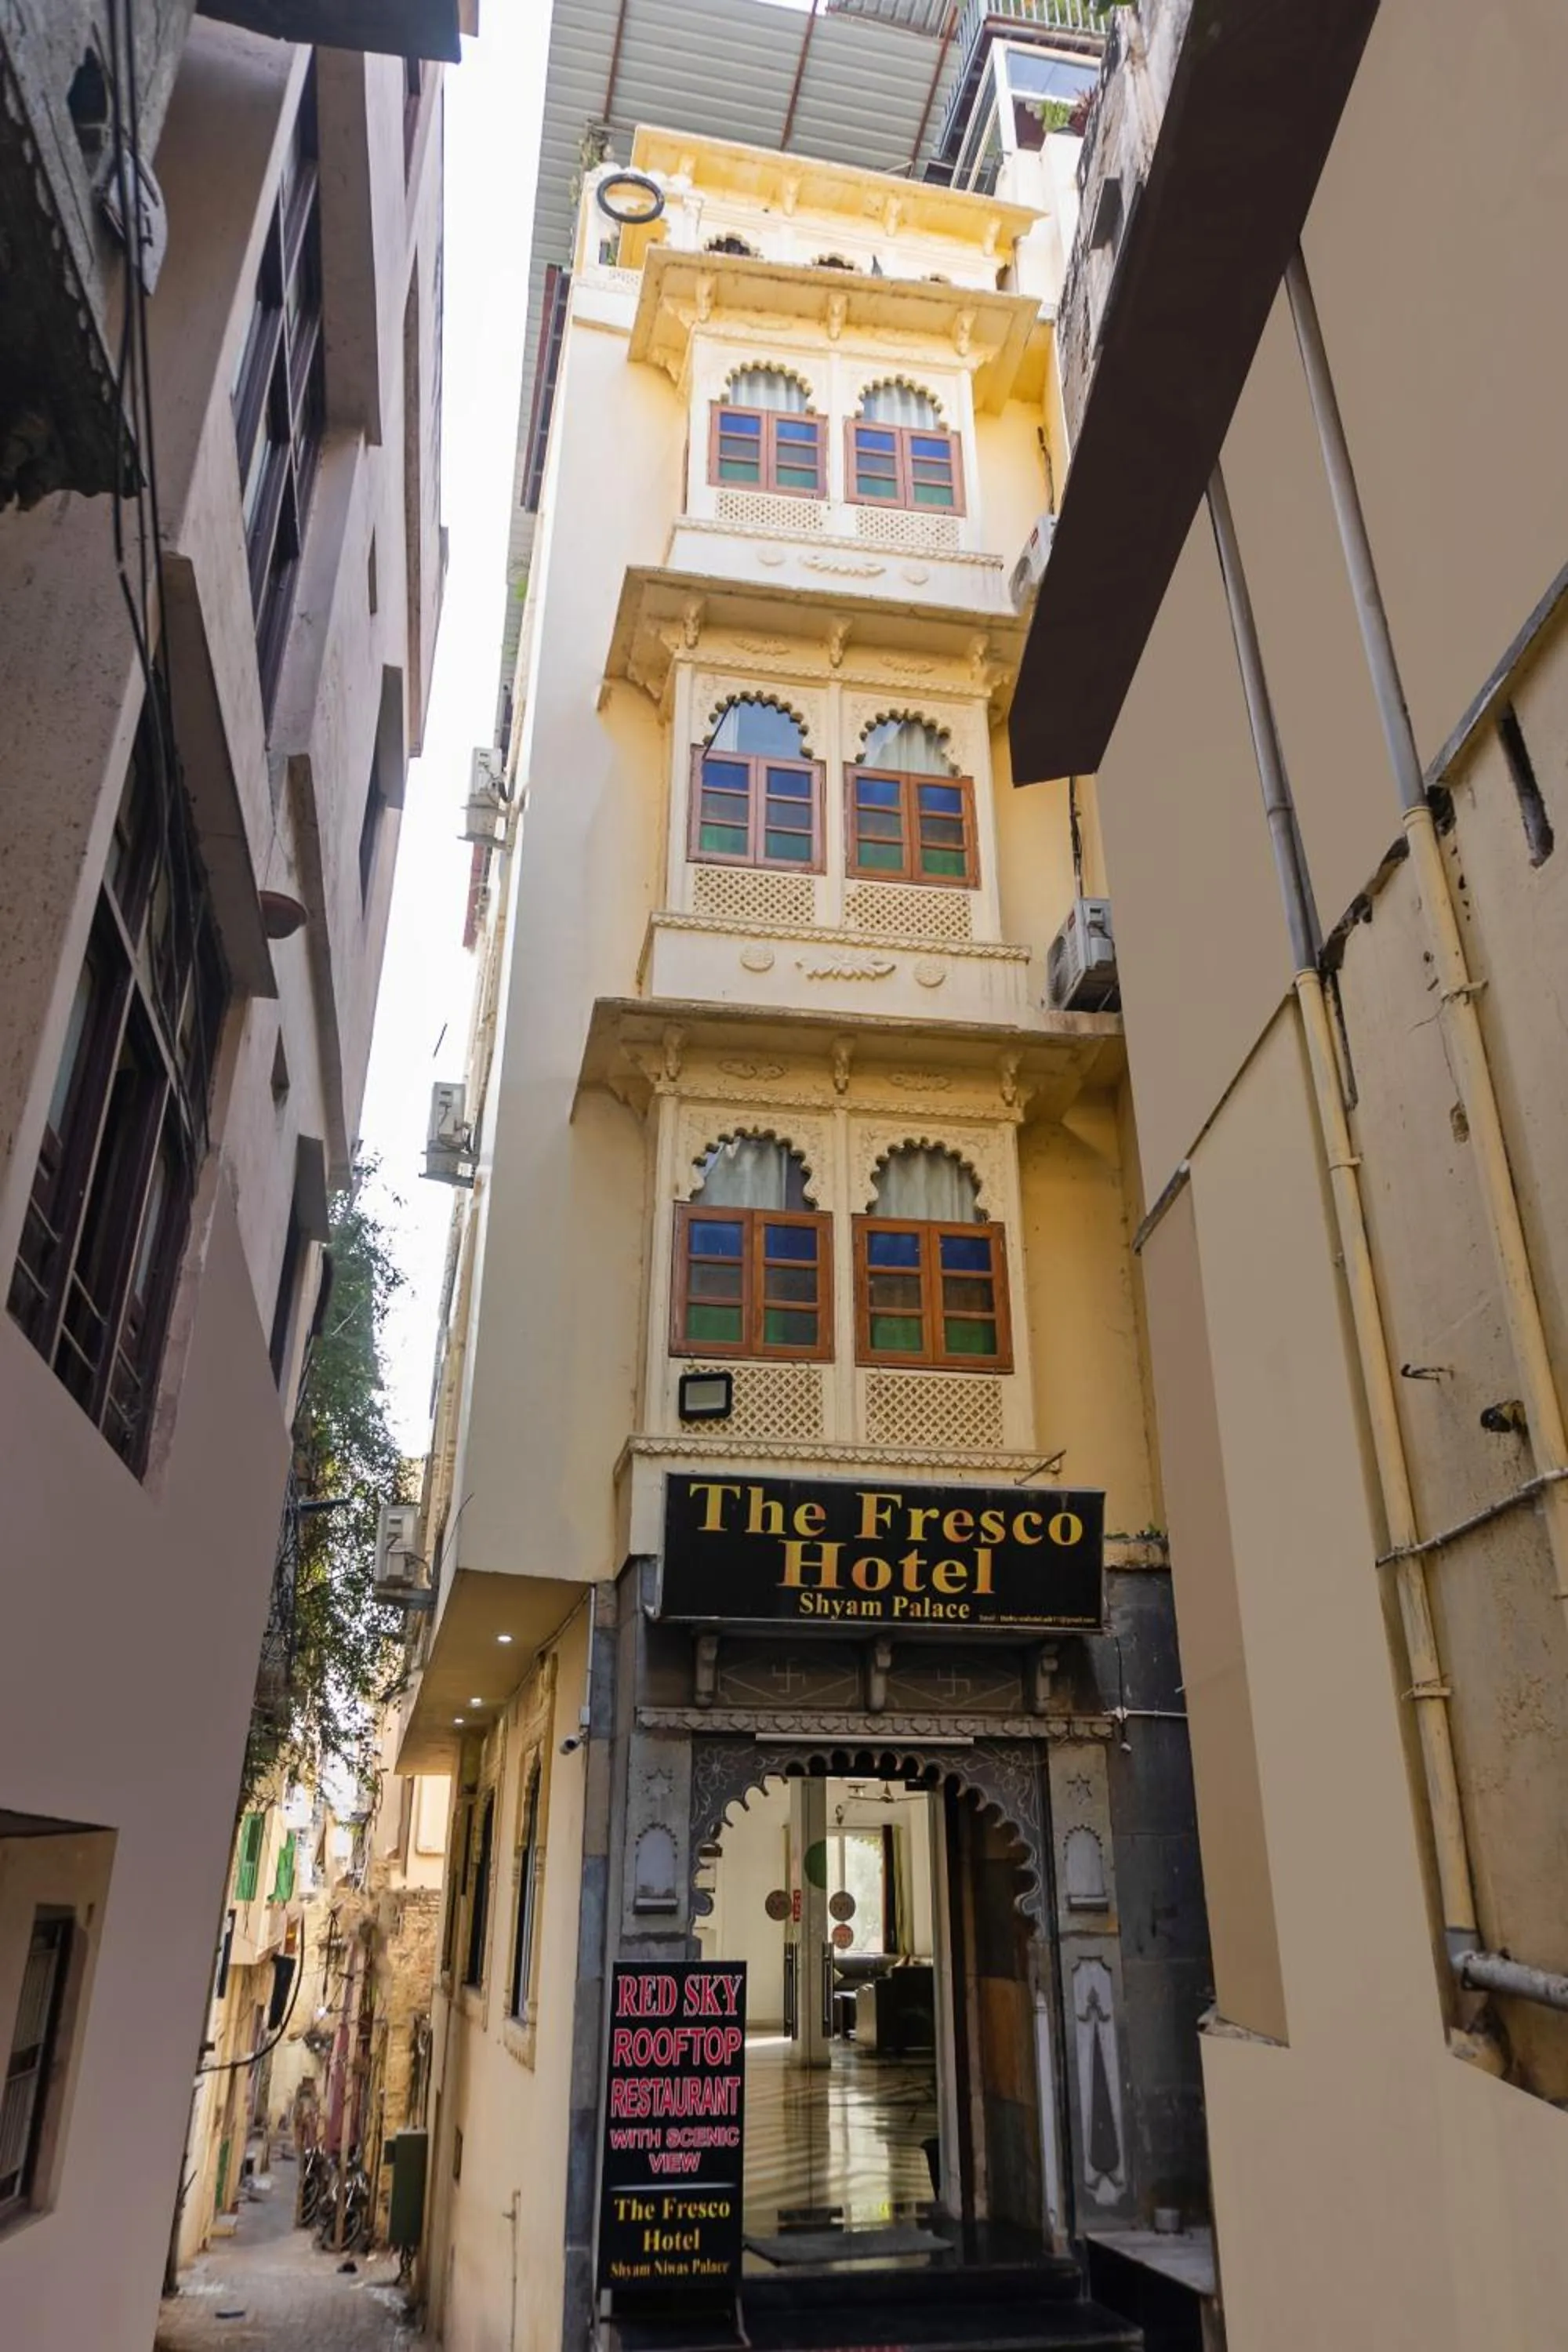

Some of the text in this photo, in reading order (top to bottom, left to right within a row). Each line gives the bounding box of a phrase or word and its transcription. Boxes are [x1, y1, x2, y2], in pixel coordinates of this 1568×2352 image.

[690, 1483, 1083, 1546] The Fresco
[776, 1539, 995, 1595] Hotel
[799, 1592, 971, 1620] Shyam Palace
[615, 1974, 743, 2019] RED SKY
[612, 2027, 742, 2068] ROOFTOP
[611, 2076, 741, 2118] RESTAURANT
[610, 2126, 740, 2150] WITH SCENIC
[648, 2152, 702, 2174] VIEW
[614, 2197, 731, 2221] The Fresco
[643, 2228, 700, 2252] Hotel
[654, 2259, 689, 2275] Niwas
[692, 2257, 731, 2274] Palace
